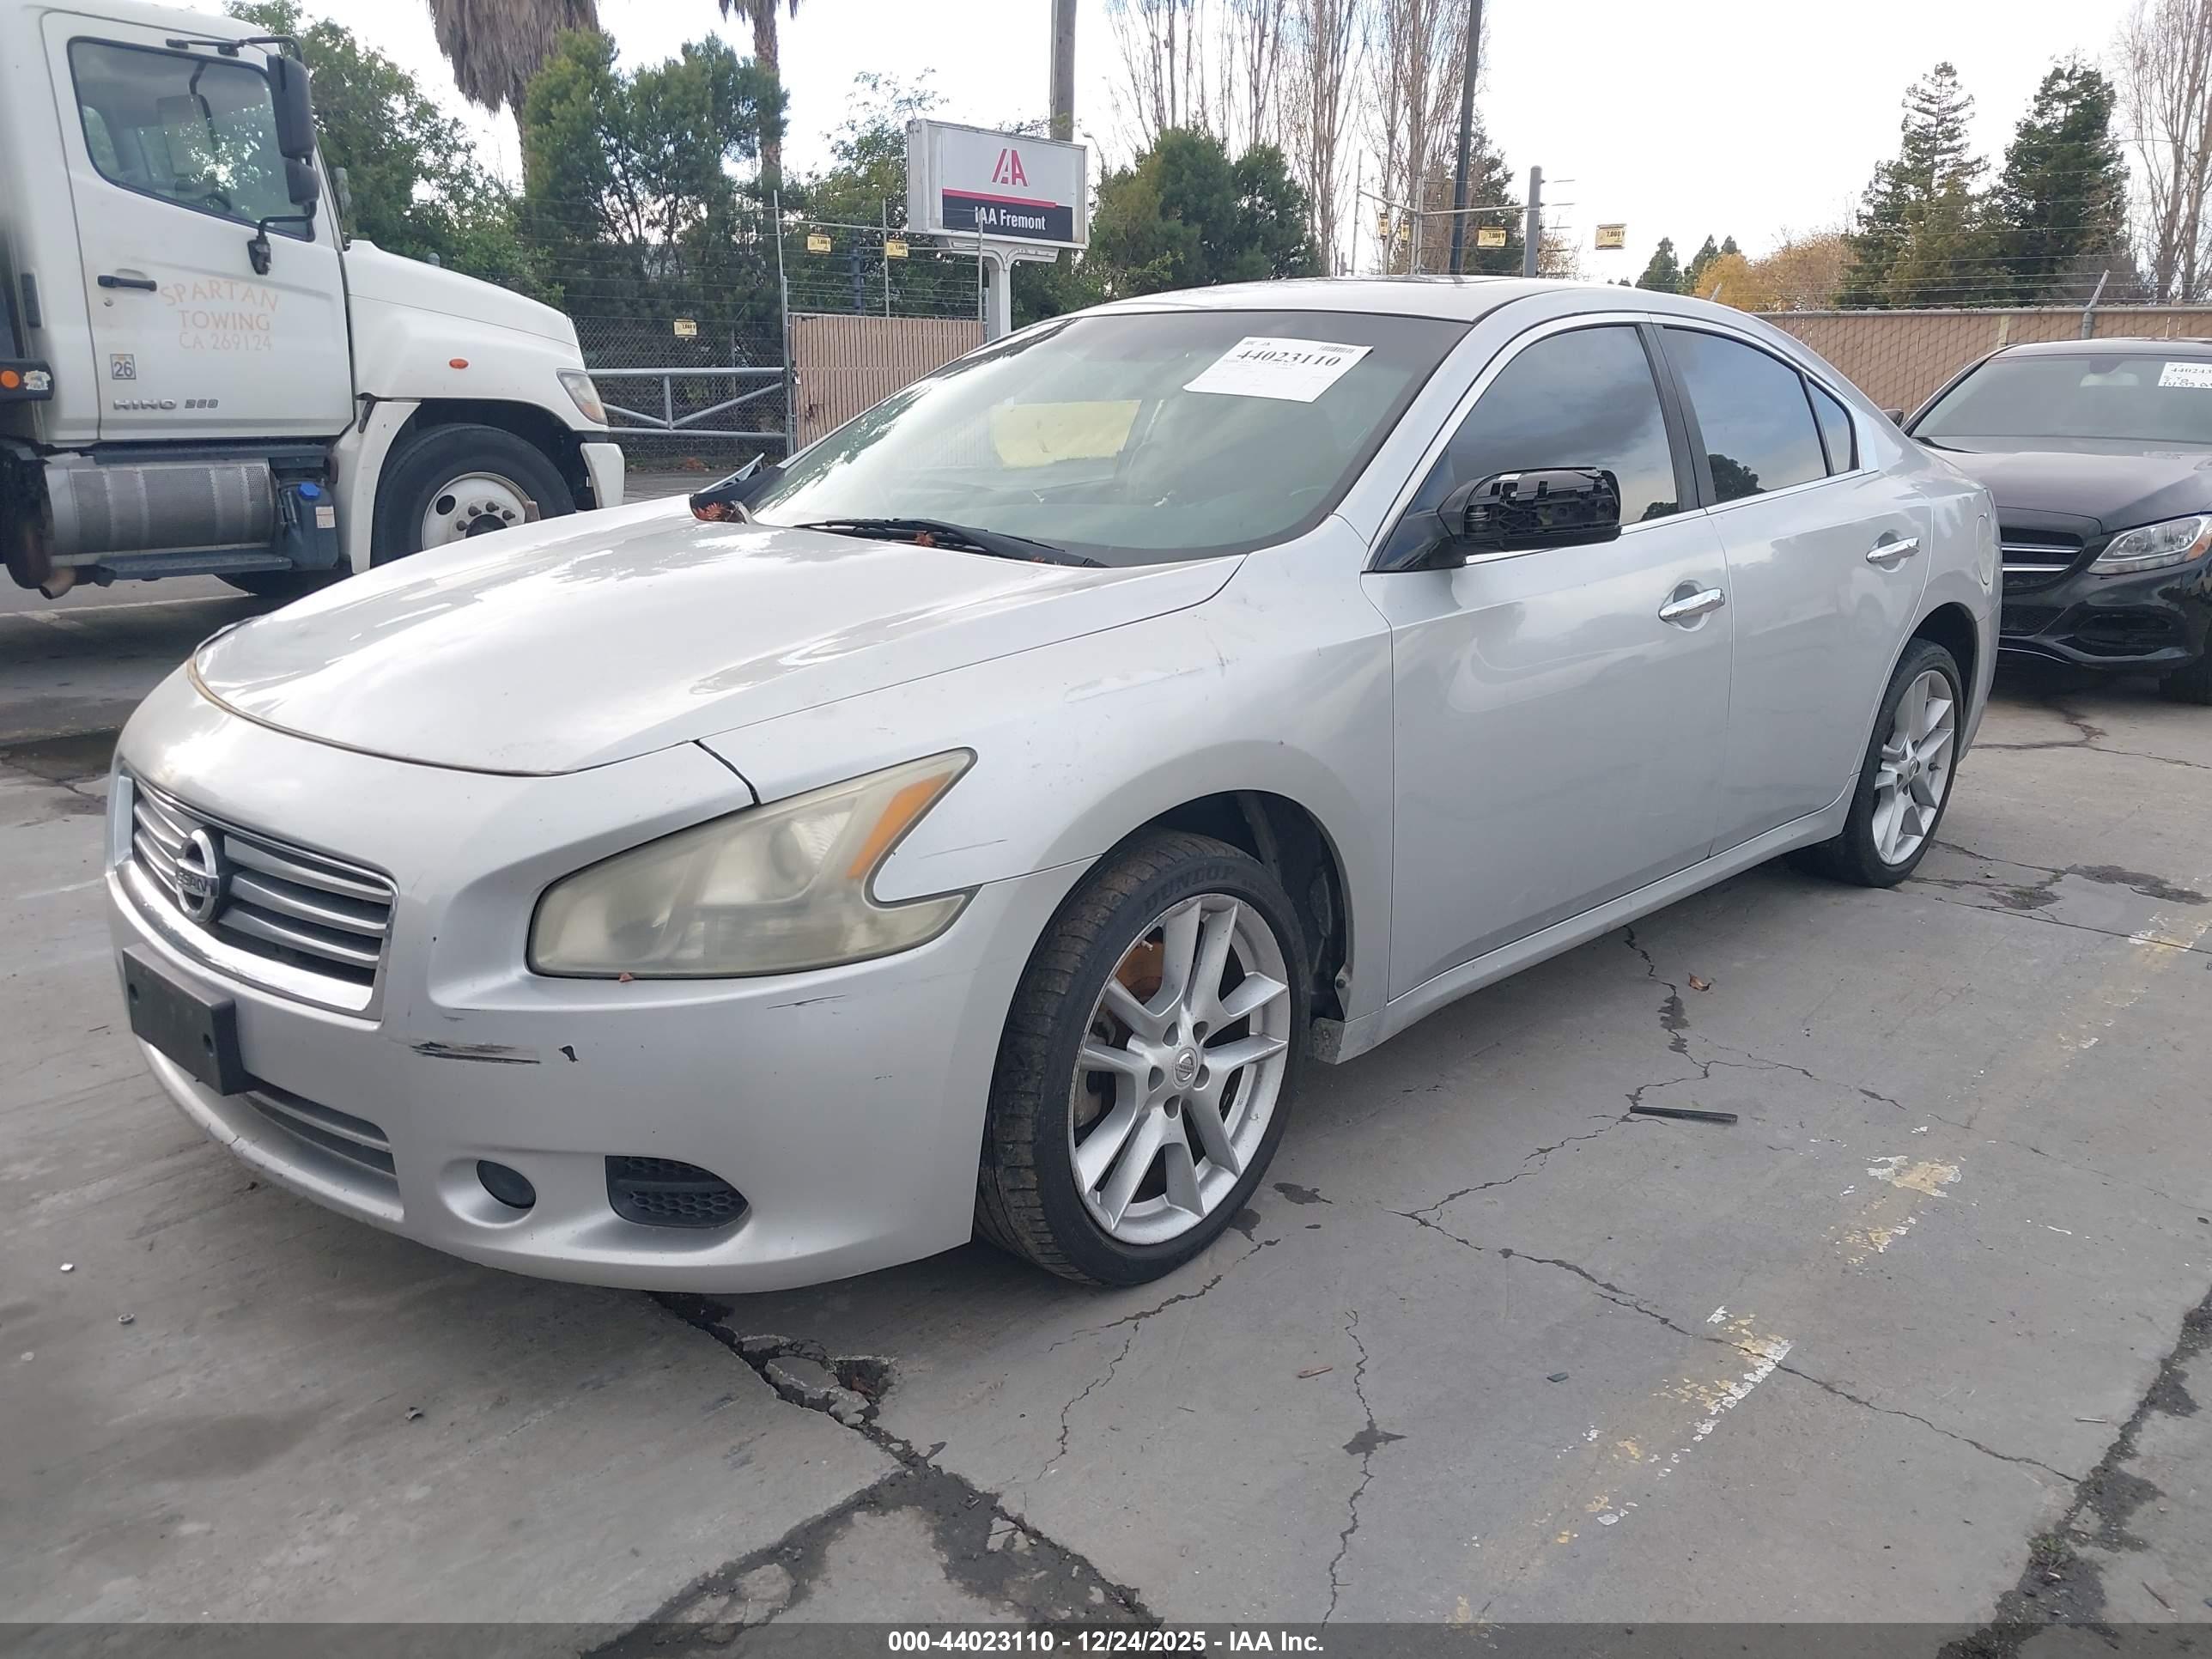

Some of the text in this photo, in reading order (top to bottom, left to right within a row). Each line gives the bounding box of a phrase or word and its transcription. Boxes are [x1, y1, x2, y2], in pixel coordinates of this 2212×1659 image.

[974, 205, 1047, 231] IAA Fremont
[160, 279, 278, 312] SPARTAN
[178, 310, 270, 331] TOWING
[179, 331, 273, 351] CA 269124
[1237, 349, 1341, 367] 44023110
[113, 361, 134, 378] 26
[113, 398, 178, 410] HINO
[1145, 865, 1237, 915] DUNLOP
